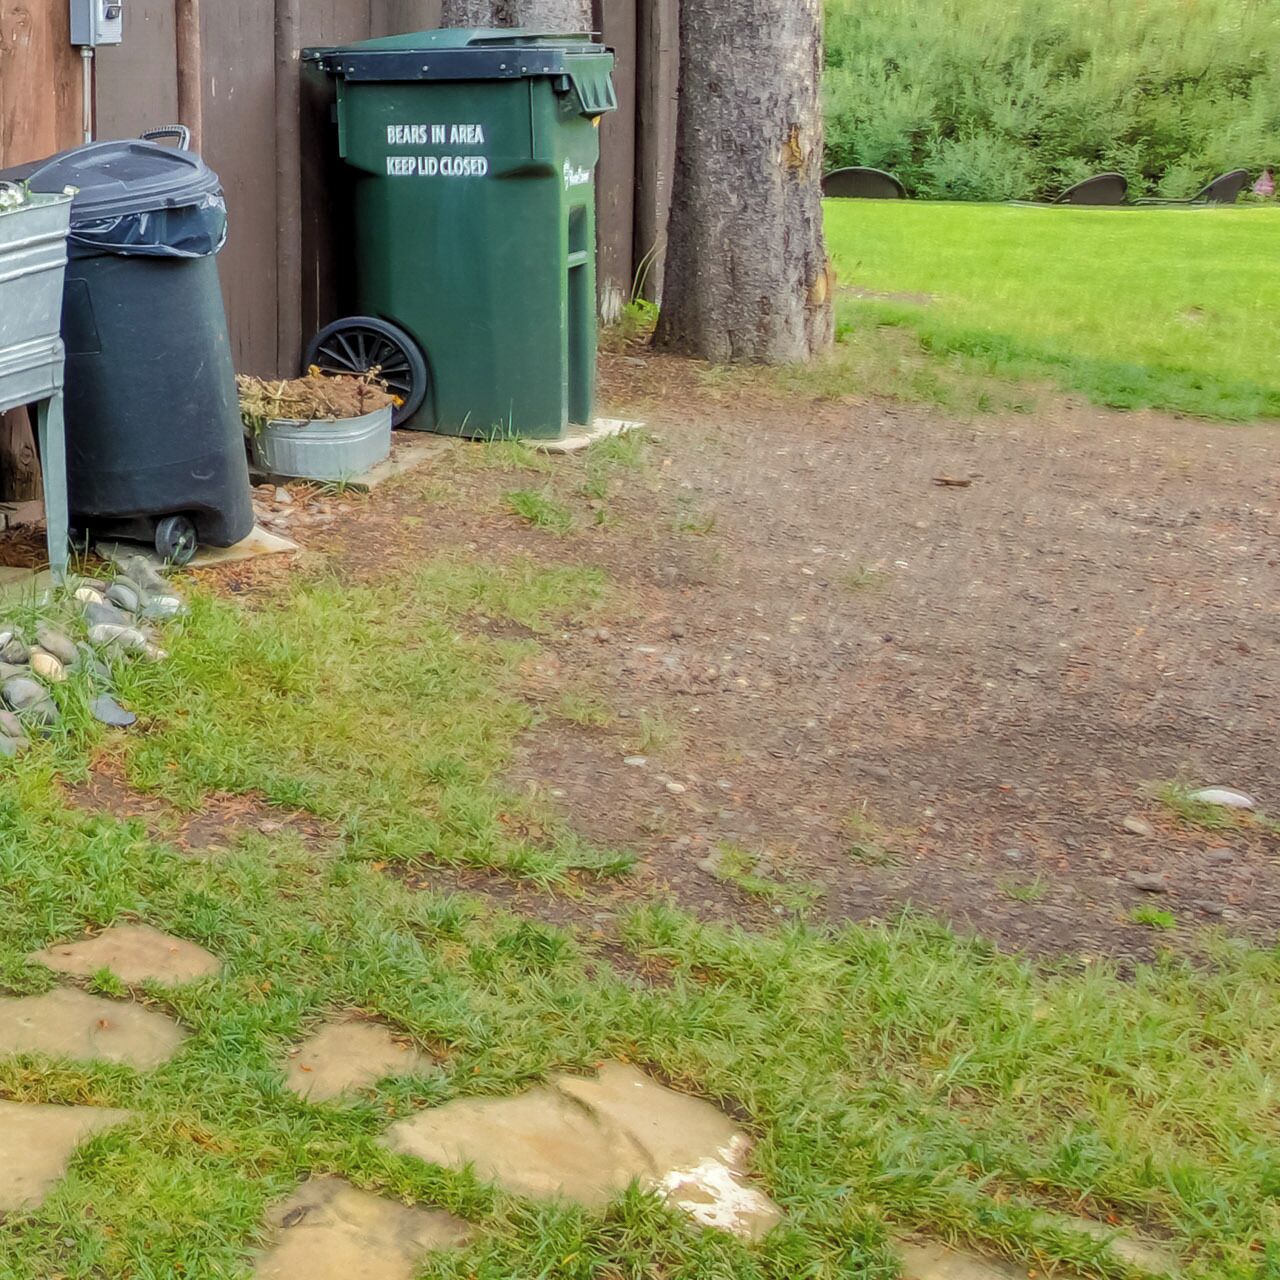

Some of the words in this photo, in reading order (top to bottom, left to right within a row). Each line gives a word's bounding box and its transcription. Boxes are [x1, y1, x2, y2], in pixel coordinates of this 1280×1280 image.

[387, 125, 428, 144] BEARS
[431, 125, 445, 144] IN
[450, 125, 484, 144] AREA
[386, 156, 417, 176] KEEP
[418, 156, 438, 176] LID
[440, 156, 488, 176] CLOSED
